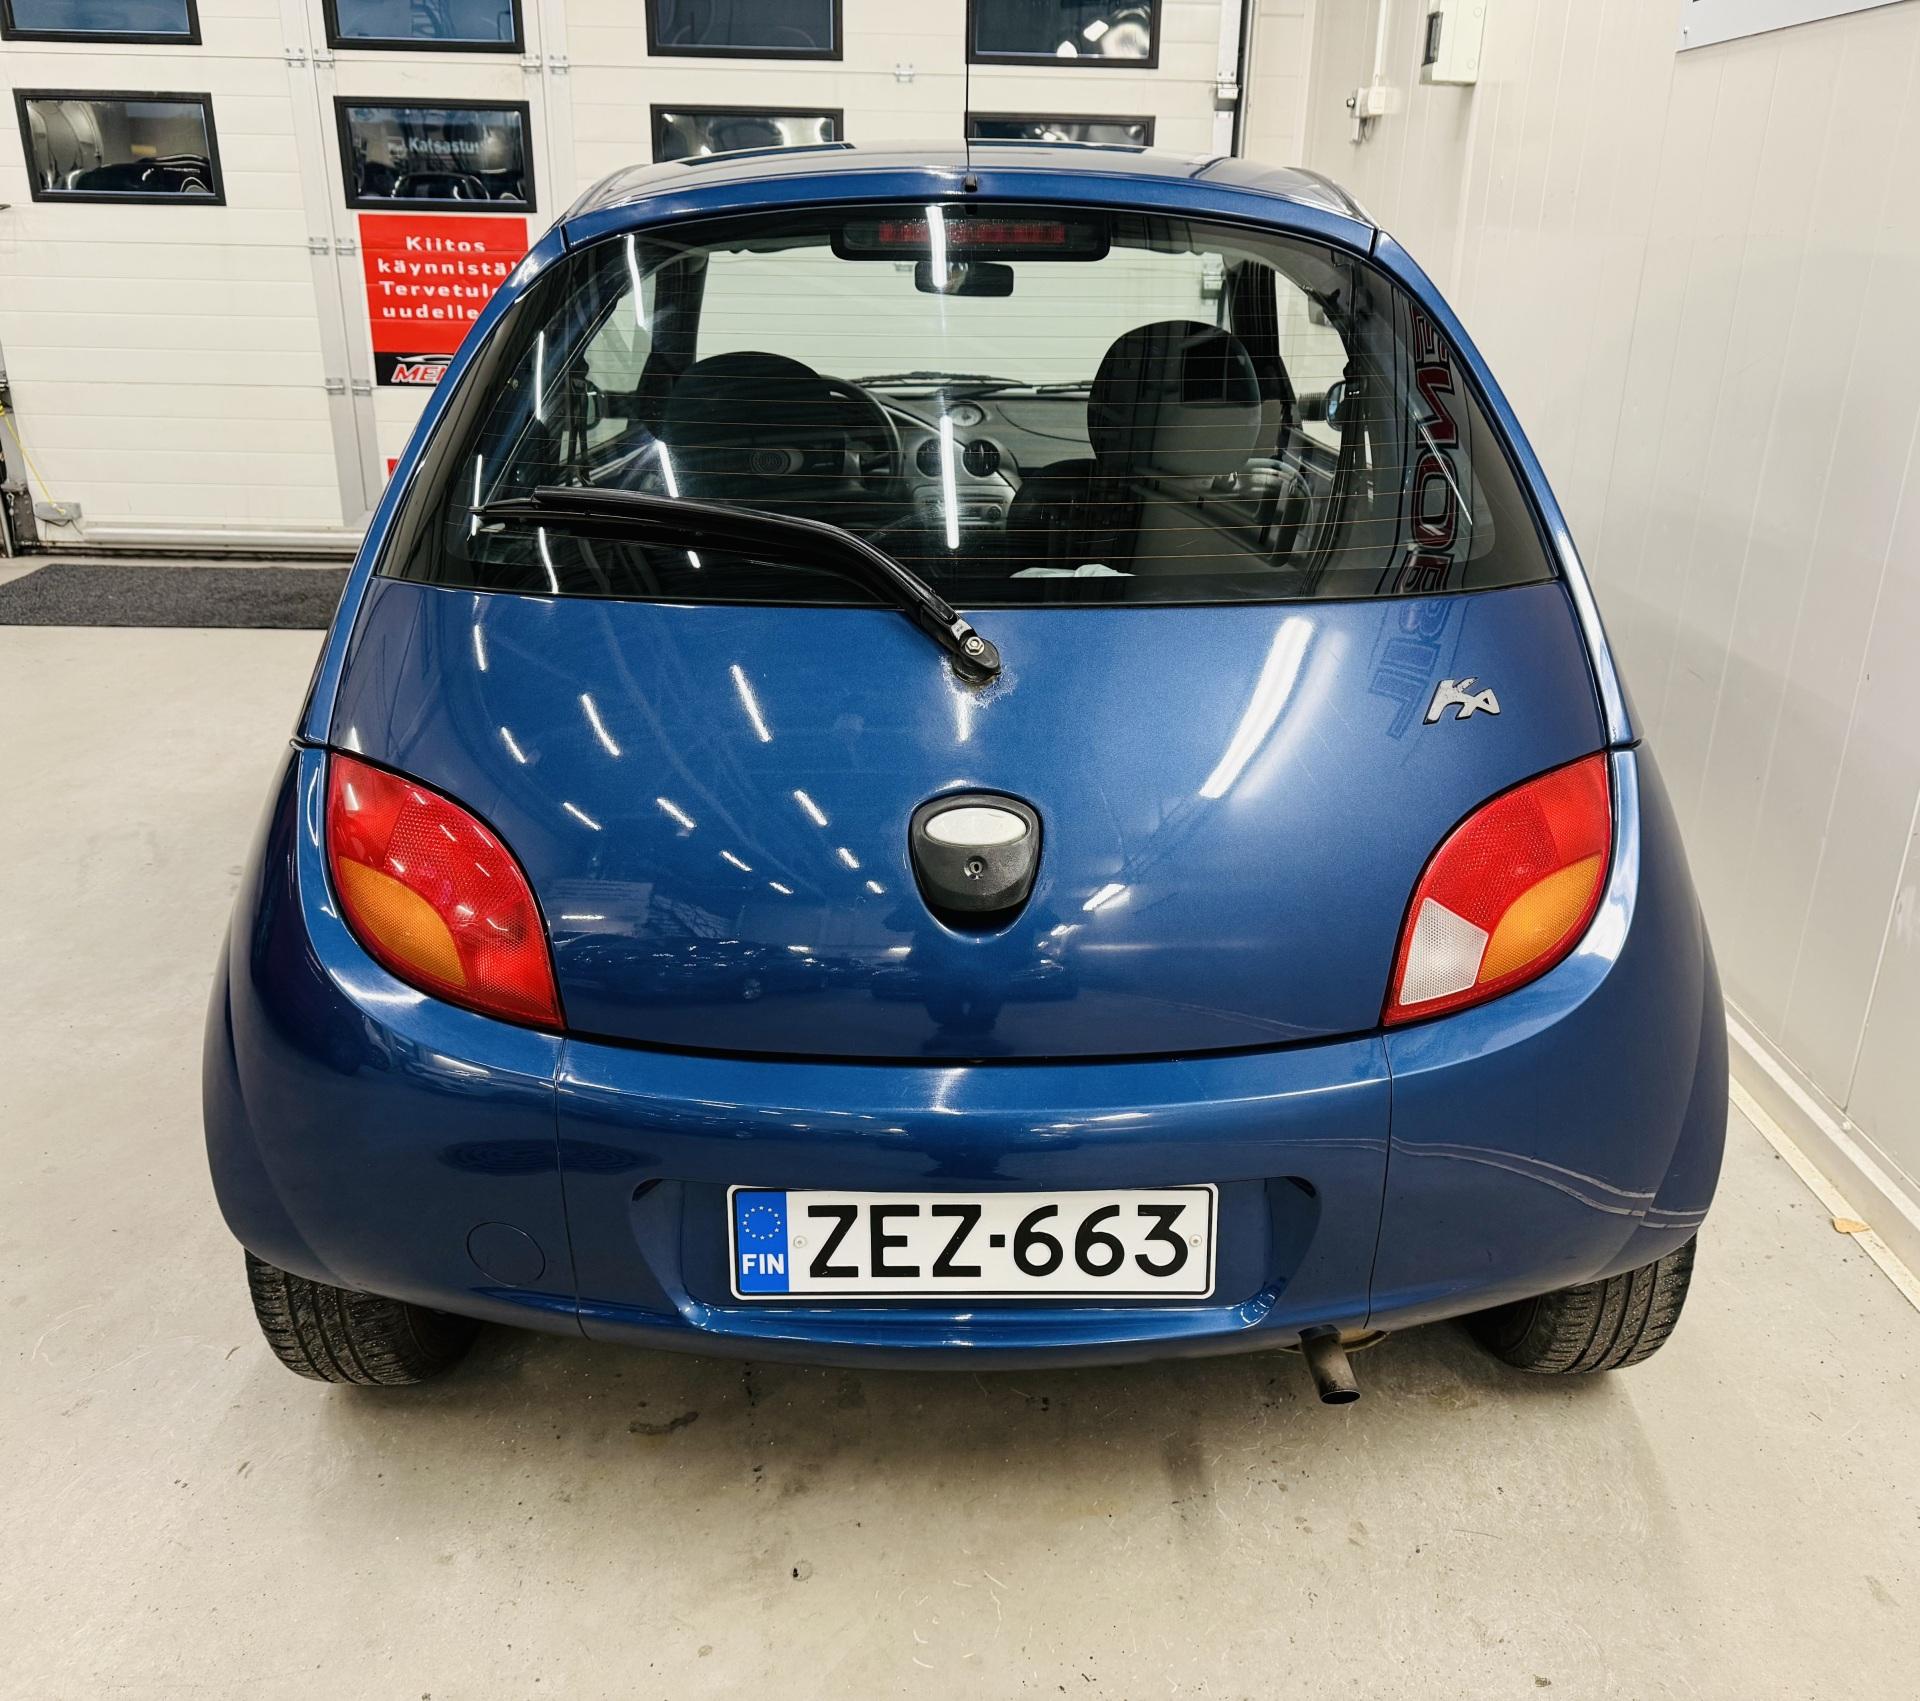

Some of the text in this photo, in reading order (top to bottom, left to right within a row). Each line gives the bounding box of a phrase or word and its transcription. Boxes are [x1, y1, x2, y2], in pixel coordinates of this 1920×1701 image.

[405, 235, 486, 253] Kiitos
[806, 1203, 1190, 1279] ZEZ-663
[741, 1252, 785, 1276] FIN
